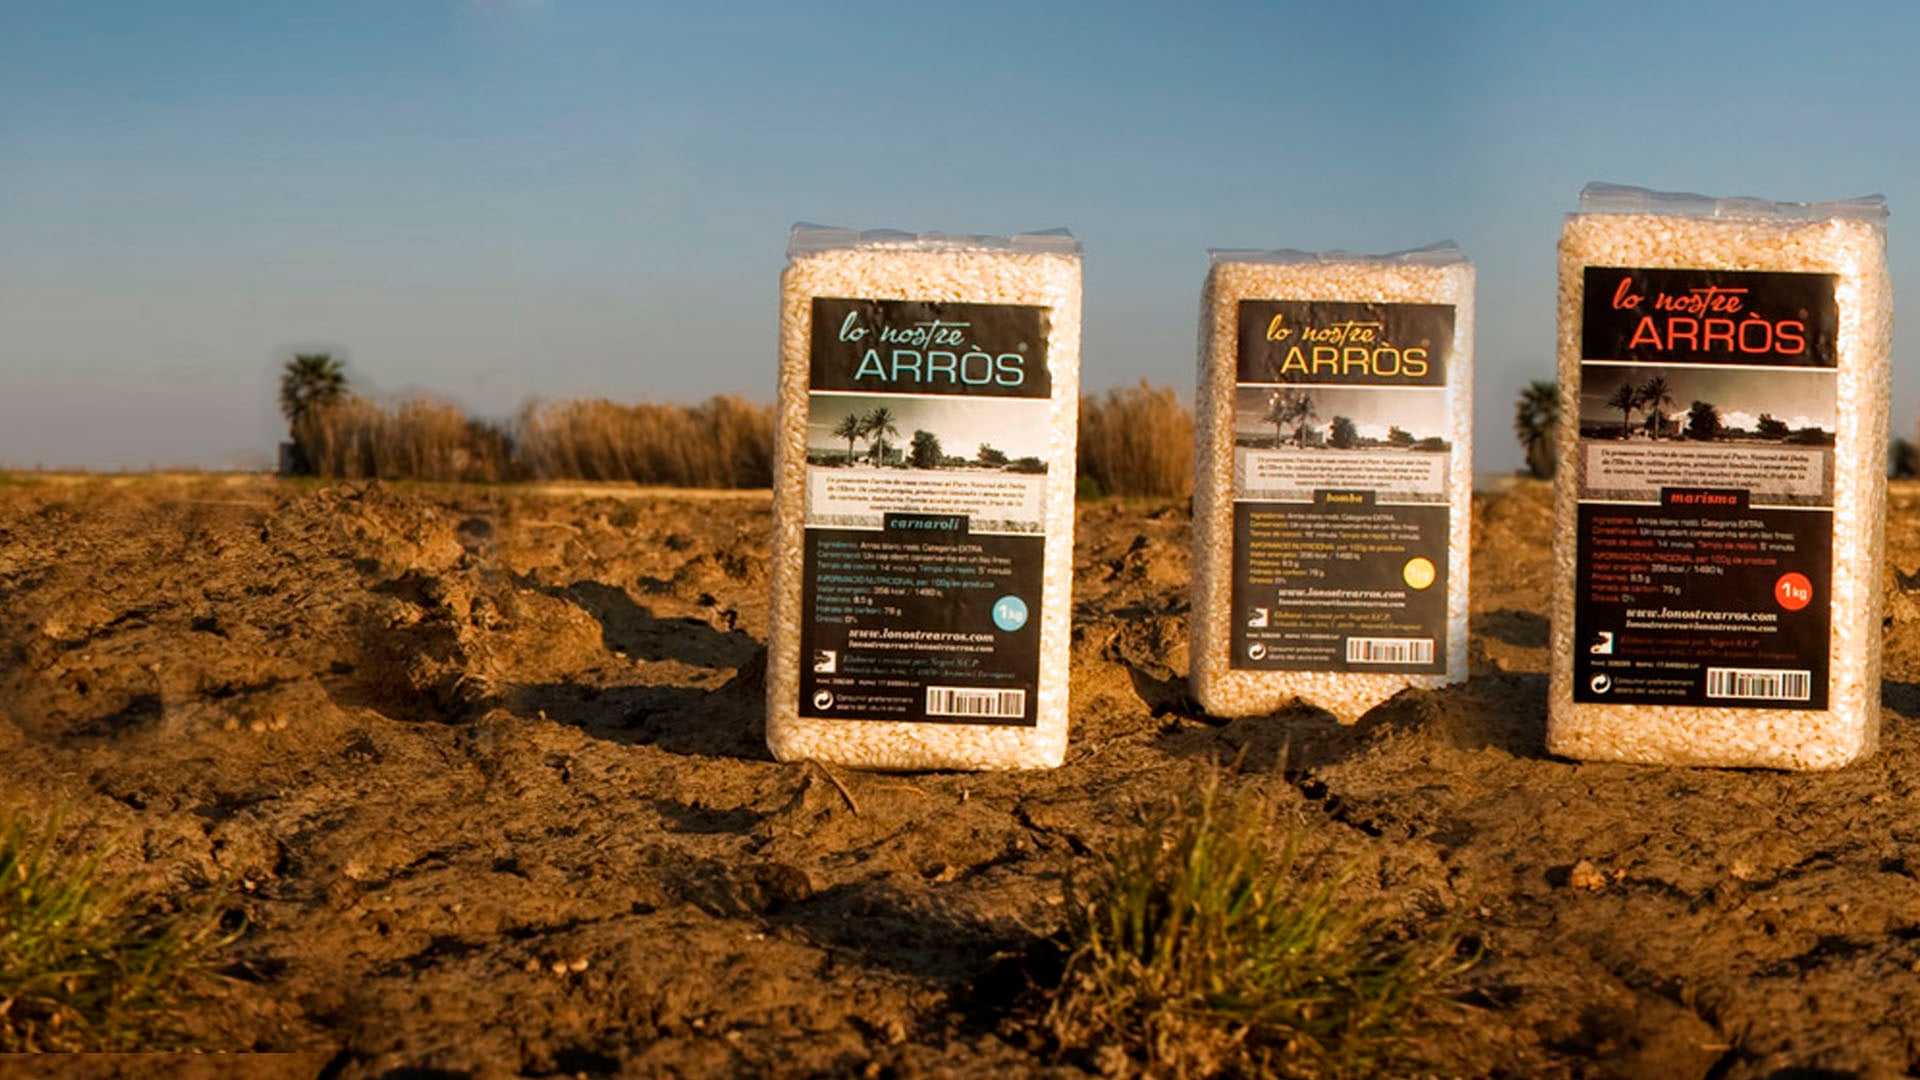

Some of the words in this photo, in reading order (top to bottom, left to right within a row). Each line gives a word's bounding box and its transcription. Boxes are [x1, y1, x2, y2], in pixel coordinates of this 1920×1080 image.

[1612, 277, 1644, 310] lo
[1655, 285, 1749, 319] nostre
[838, 311, 868, 342] lo
[881, 320, 970, 350] nostre
[1266, 313, 1292, 341] lo
[1302, 320, 1382, 346] nostre
[1629, 311, 1806, 354] ARRÒS
[854, 345, 1024, 386] ARRÒS
[1280, 341, 1428, 377] ARRÒS
[1327, 493, 1362, 503] bomba
[1671, 491, 1737, 505] marisma
[890, 518, 959, 531] carnaroli
[1278, 587, 1406, 599] www.lonostrearros.com
[1626, 607, 1778, 622] www.lonostrearros.com
[848, 628, 995, 642] www.lonostrearros.com
